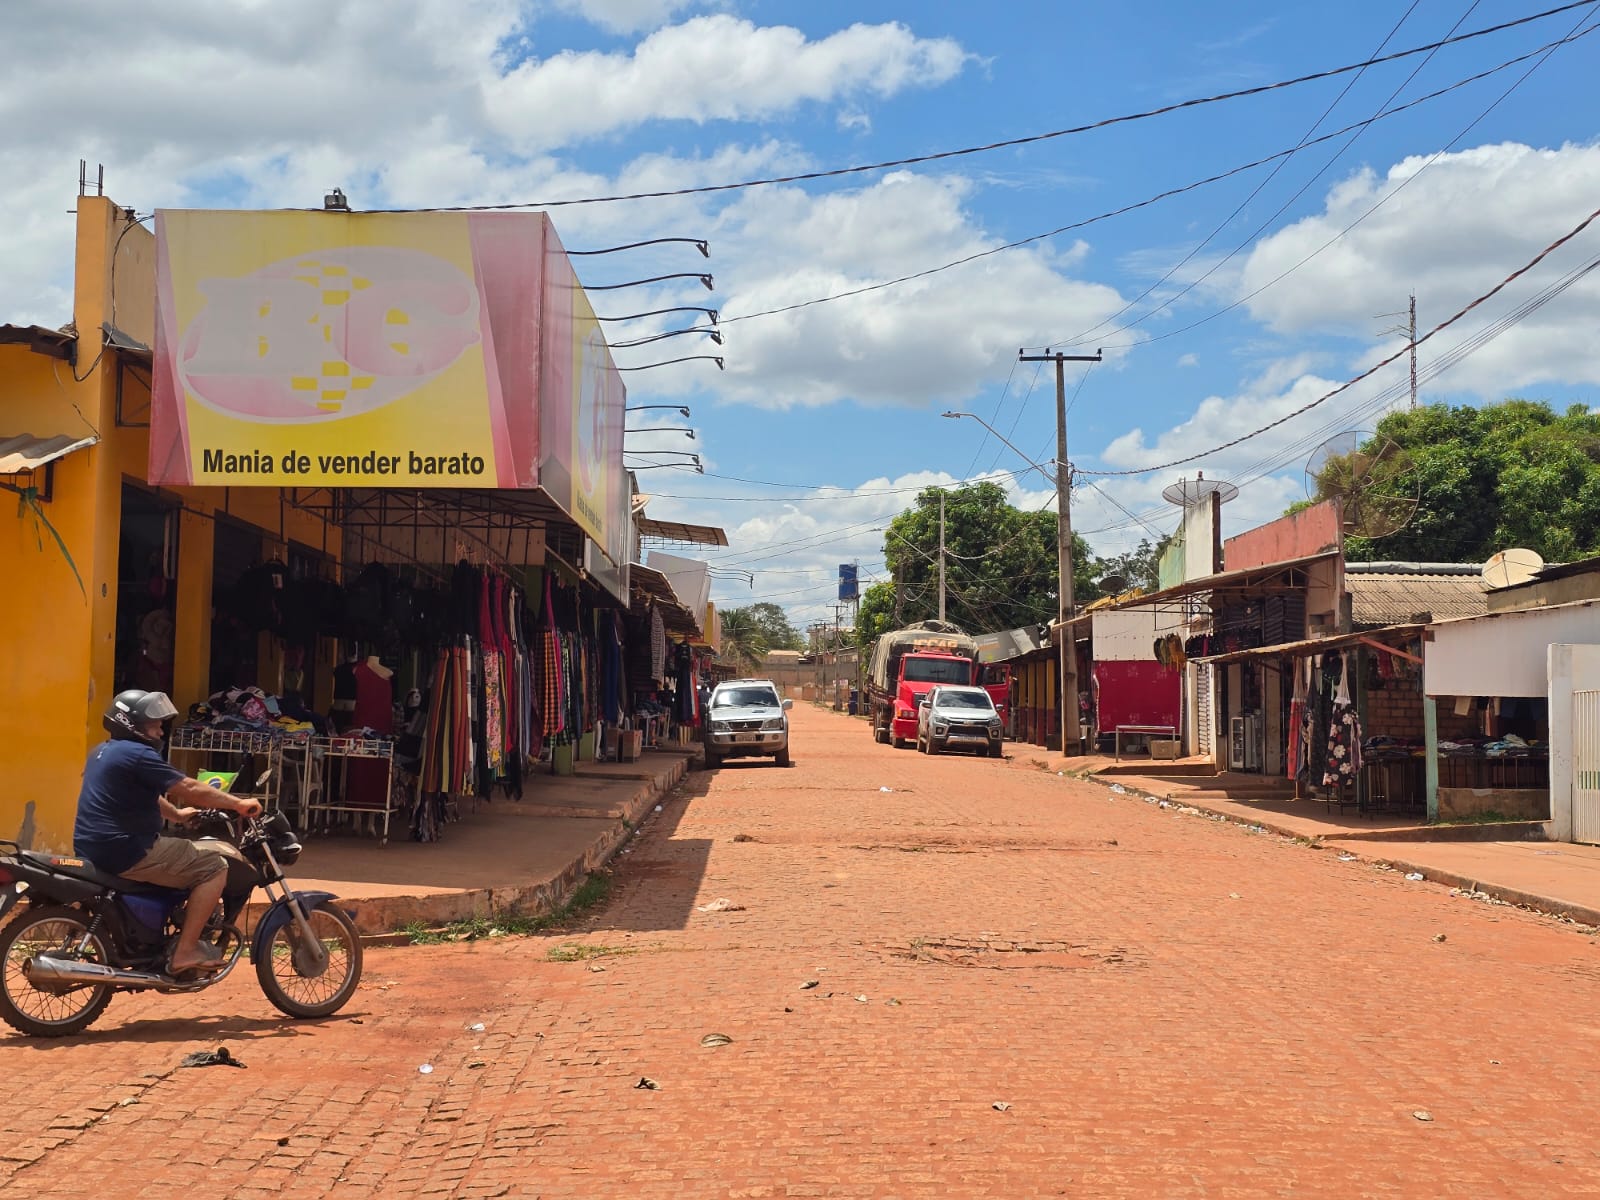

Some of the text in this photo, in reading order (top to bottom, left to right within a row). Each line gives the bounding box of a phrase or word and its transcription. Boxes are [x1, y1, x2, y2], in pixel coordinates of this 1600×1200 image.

[203, 448, 485, 475] Mania de vender barato
